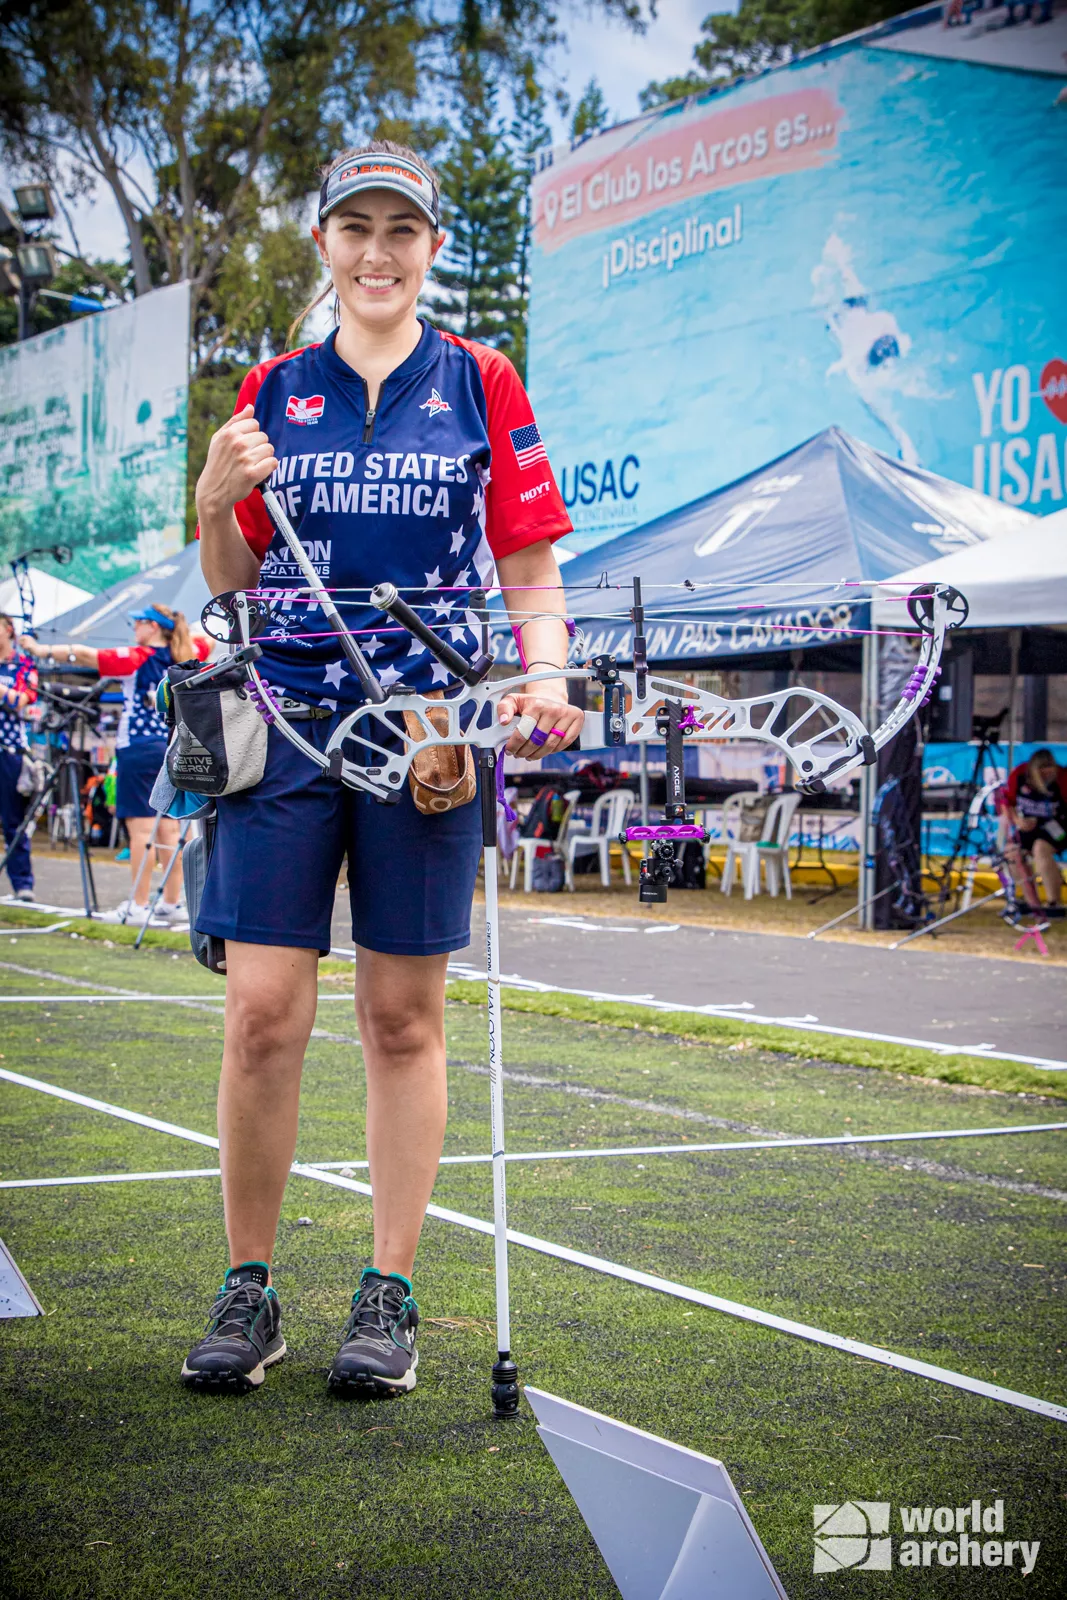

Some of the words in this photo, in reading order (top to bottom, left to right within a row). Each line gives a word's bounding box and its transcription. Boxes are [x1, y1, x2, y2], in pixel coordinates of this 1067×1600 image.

[360, 165, 423, 187] EASTON
[561, 183, 583, 221] El
[586, 162, 642, 211] Club
[647, 156, 683, 193] los
[687, 126, 768, 181] Arcos
[774, 112, 834, 151] es...
[972, 364, 1031, 438] YO
[267, 452, 355, 488] NITED
[364, 453, 471, 484] STATES
[520, 481, 550, 502] HOYT
[562, 454, 640, 508] USAC
[973, 433, 1067, 506] USA
[310, 482, 450, 518] AMERICA
[729, 604, 853, 650] GANADOR
